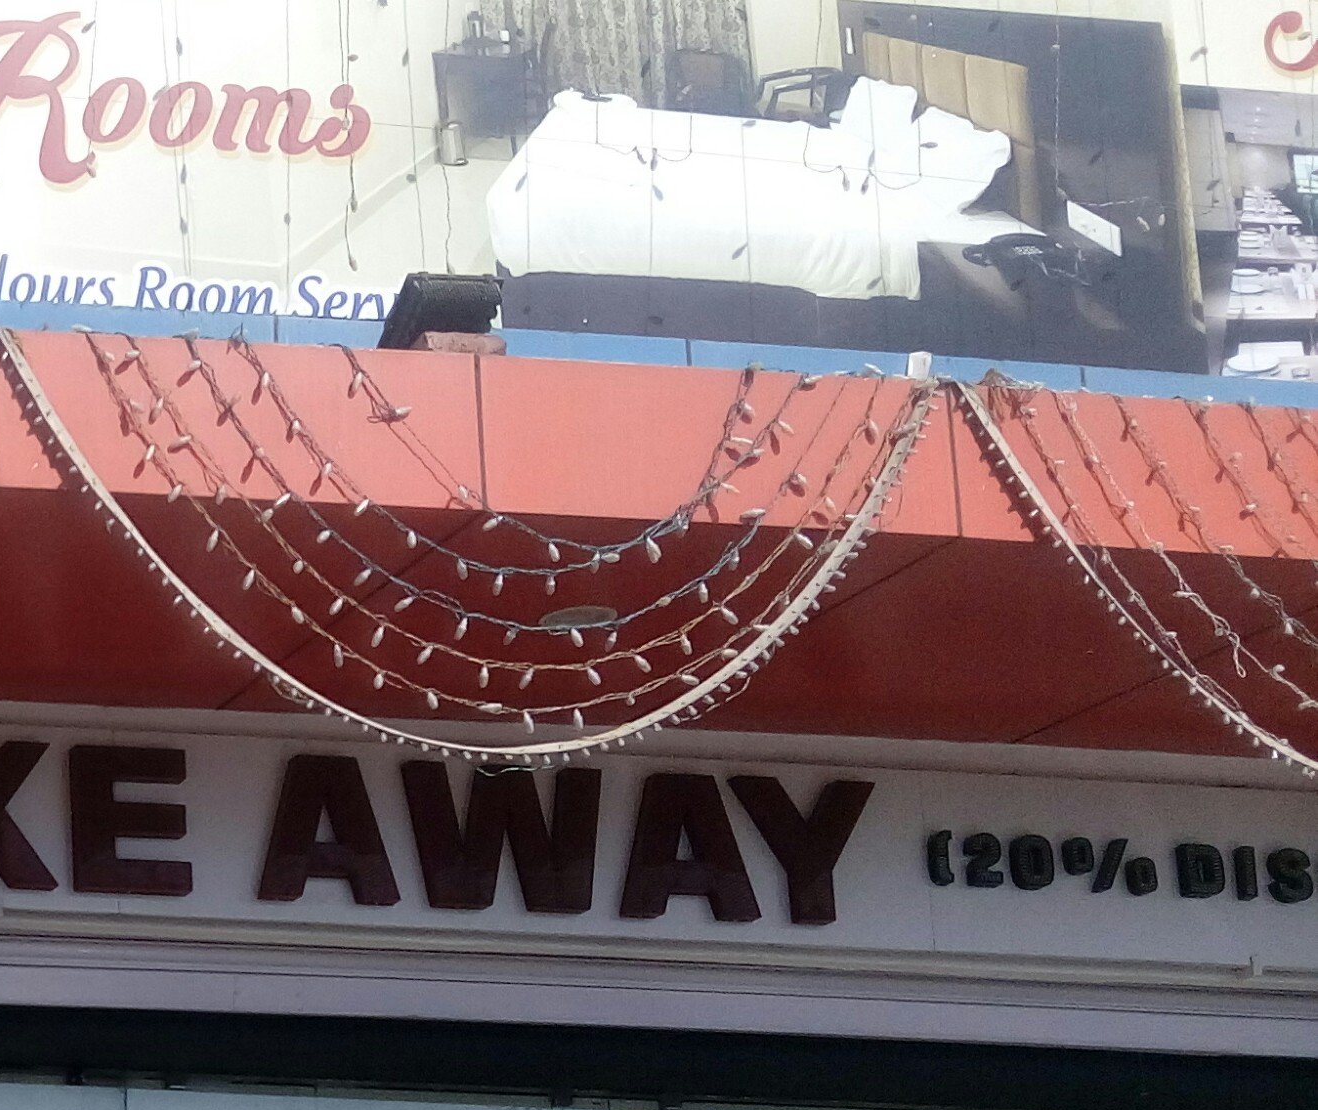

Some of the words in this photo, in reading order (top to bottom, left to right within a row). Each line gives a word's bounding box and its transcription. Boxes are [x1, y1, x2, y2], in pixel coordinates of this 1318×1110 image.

[135, 265, 277, 316] Room
[253, 752, 877, 928] AWAY
[926, 829, 1159, 897] (20%
[1174, 842, 1318, 904] DIS
